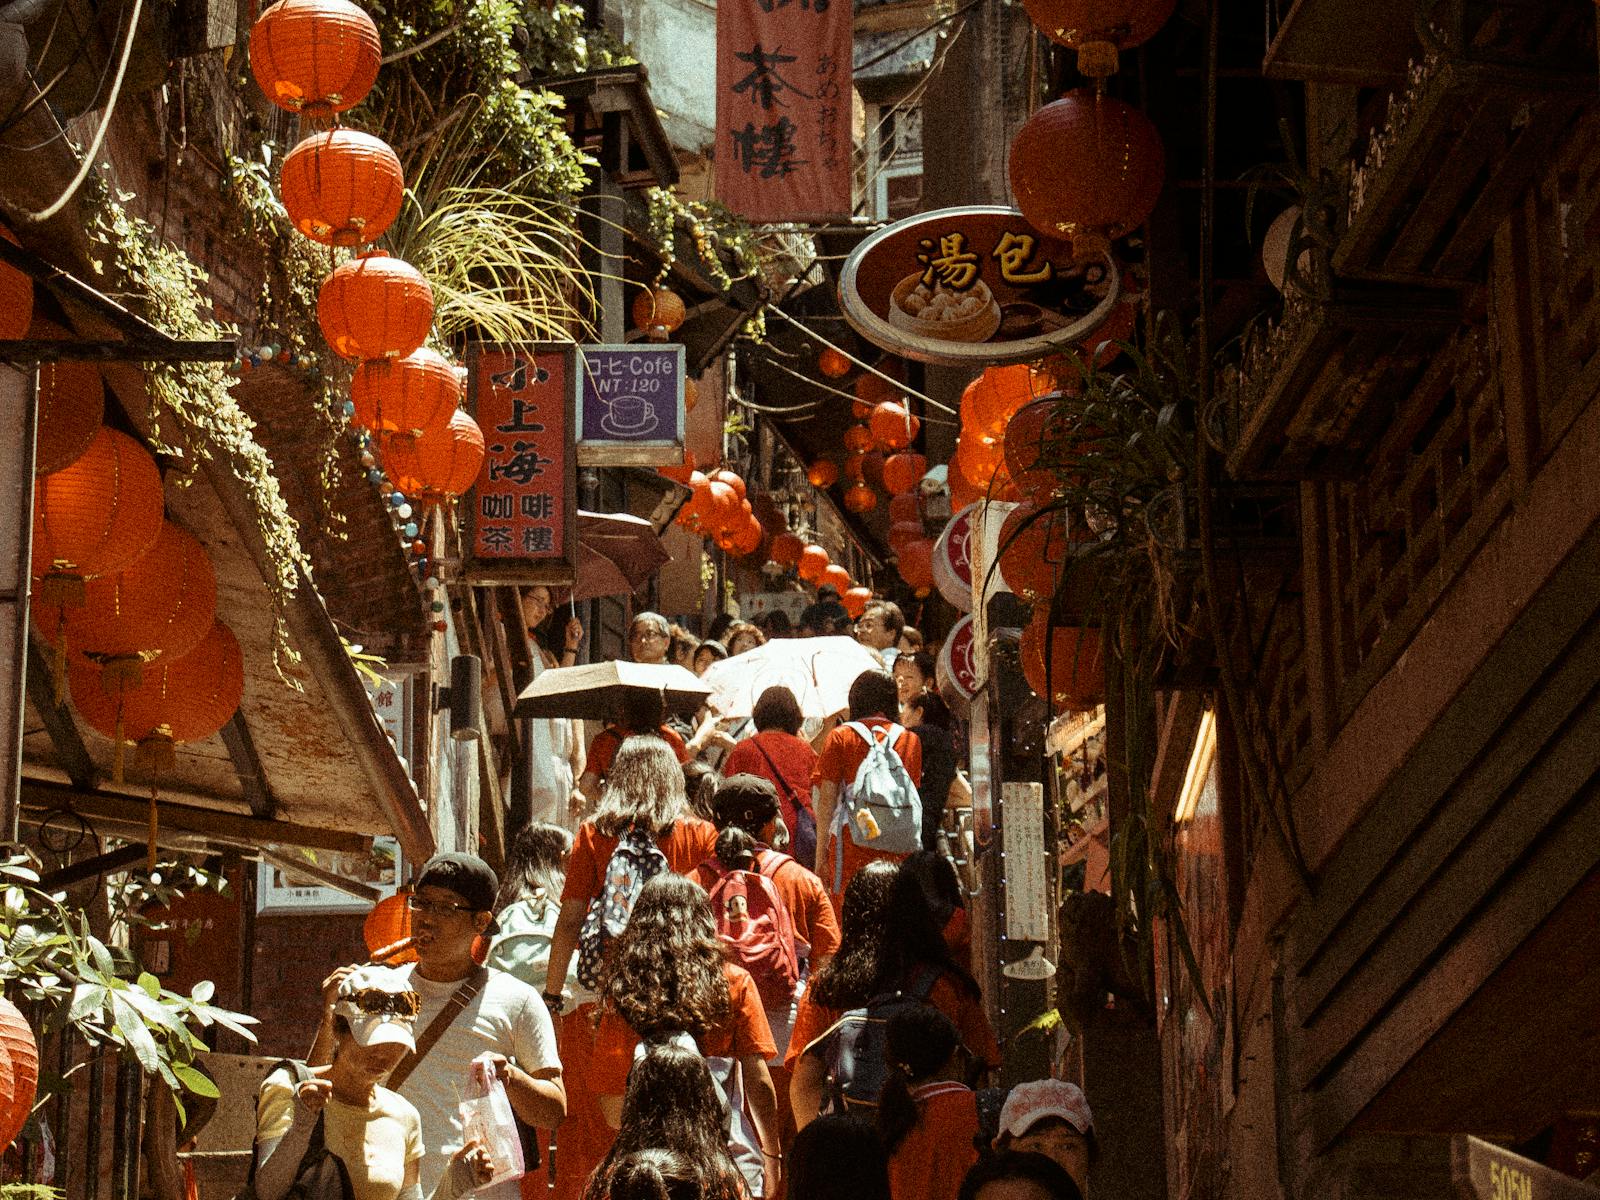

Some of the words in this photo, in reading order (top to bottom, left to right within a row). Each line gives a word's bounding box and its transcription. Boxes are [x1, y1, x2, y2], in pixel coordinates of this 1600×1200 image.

[731, 0, 829, 180] 茶樓
[917, 230, 1053, 289] 湯包
[489, 358, 553, 486] 小上海
[482, 493, 555, 520] 咖啡
[481, 526, 555, 553] 茶樓
